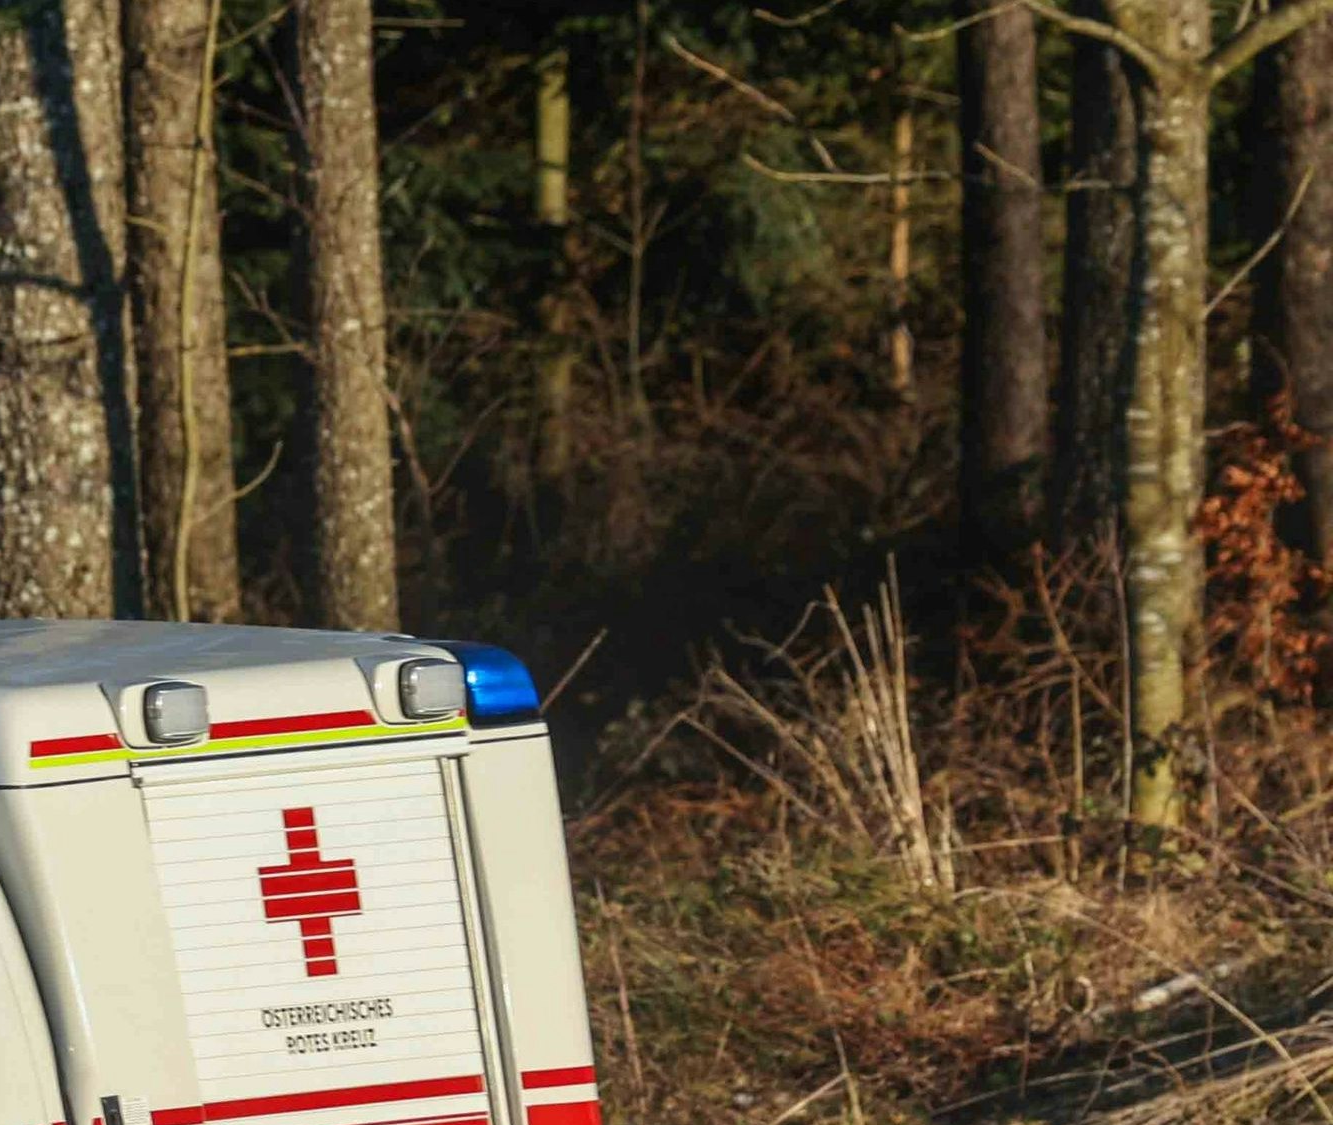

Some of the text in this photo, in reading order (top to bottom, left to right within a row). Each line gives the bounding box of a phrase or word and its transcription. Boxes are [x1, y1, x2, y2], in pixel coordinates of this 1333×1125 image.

[261, 998, 393, 1028] ÖSTERREICHISCHES
[286, 1027, 377, 1055] ROTES KREUZ
